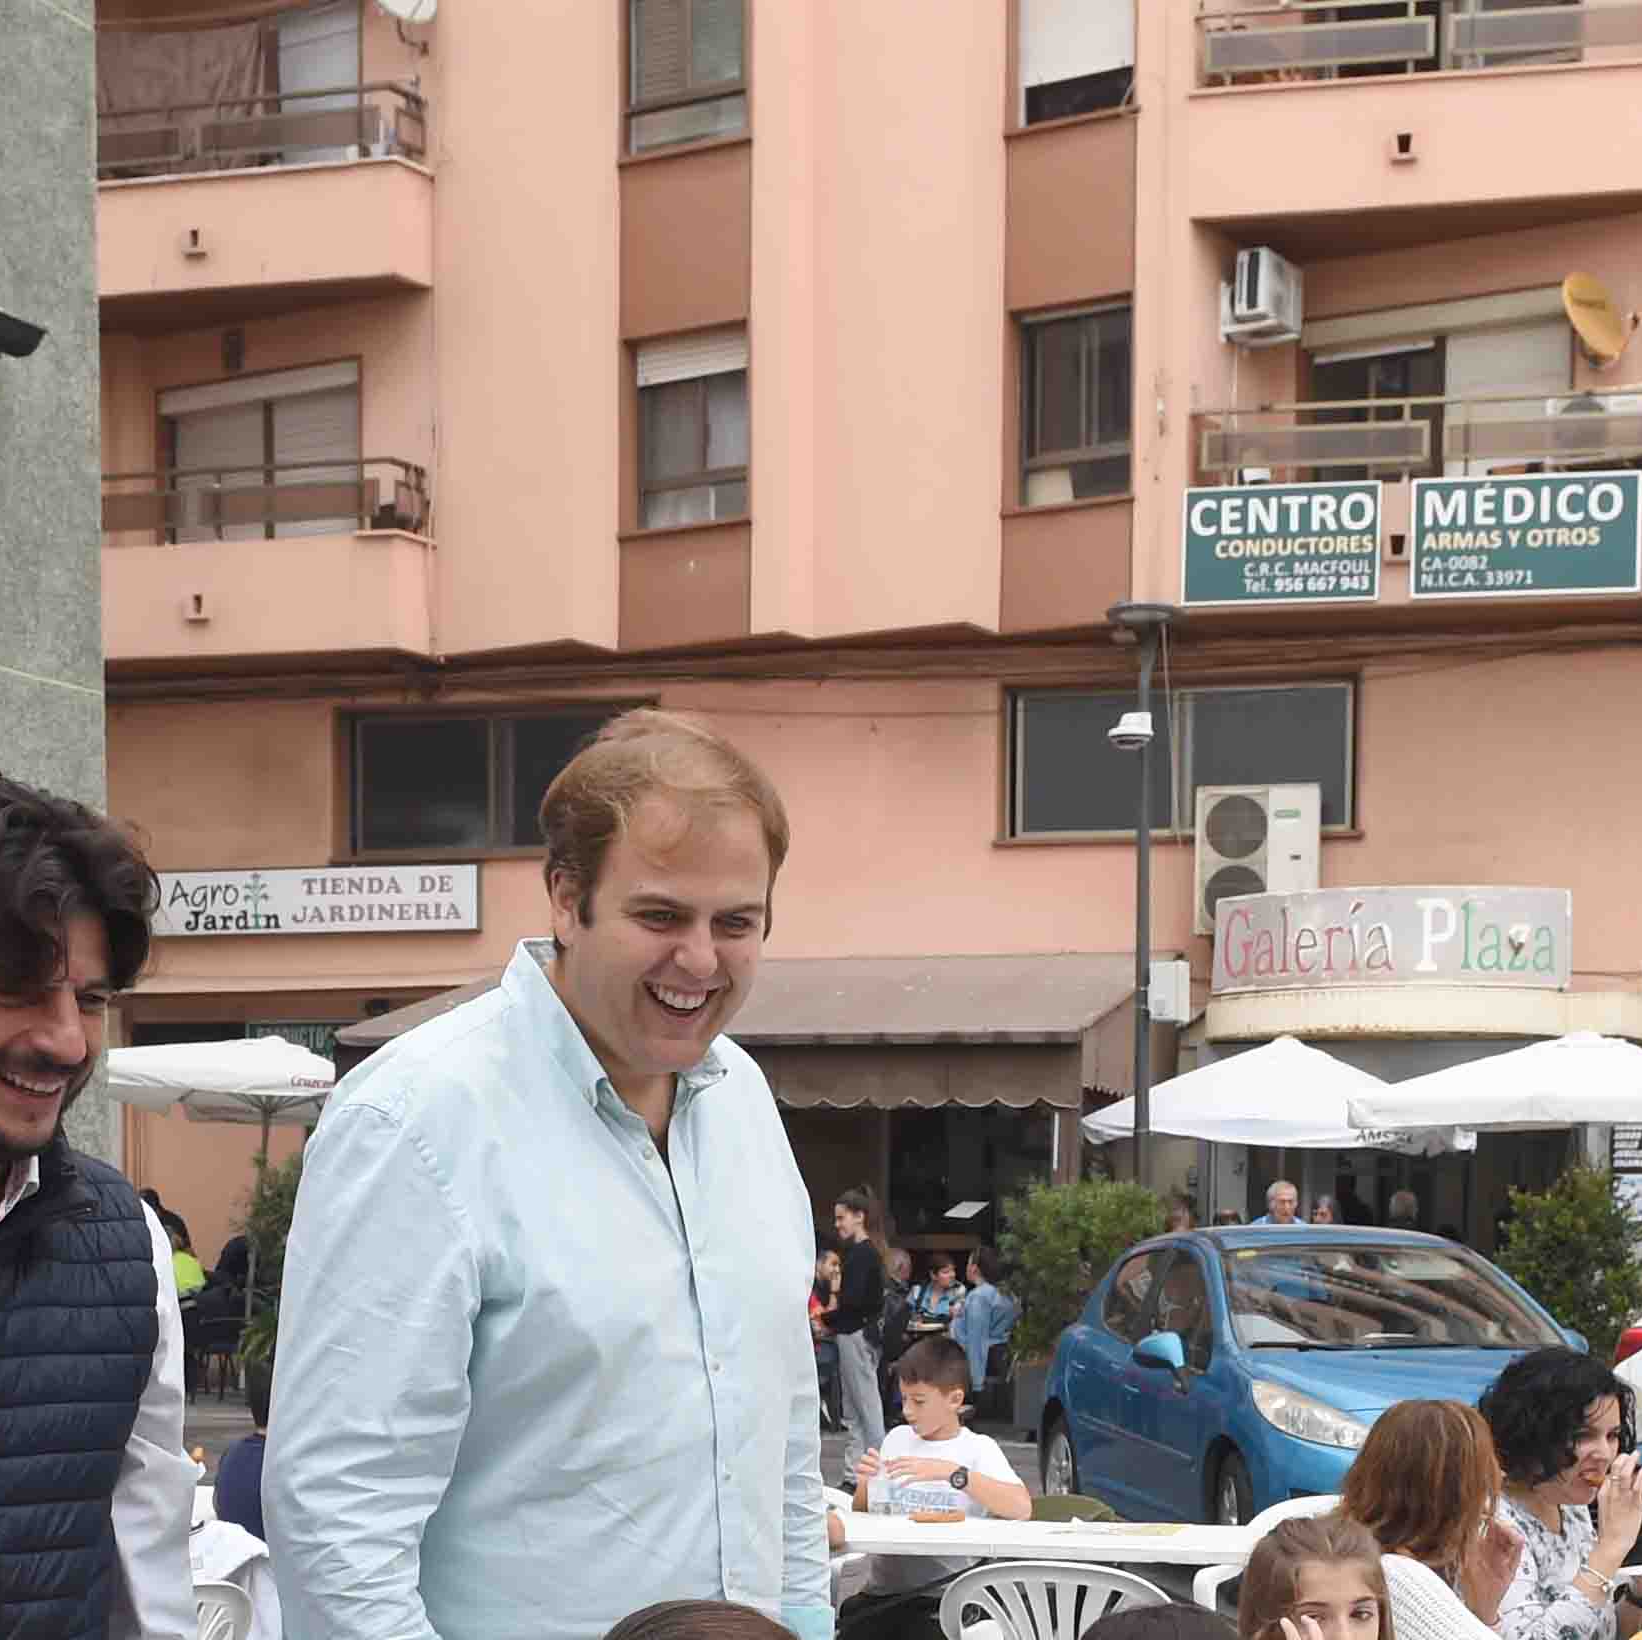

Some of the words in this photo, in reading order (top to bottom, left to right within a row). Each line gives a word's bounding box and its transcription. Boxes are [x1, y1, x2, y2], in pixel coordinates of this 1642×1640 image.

[1190, 492, 1375, 536] CENTRO
[1424, 482, 1624, 527] MÉDICO
[1214, 535, 1374, 559] CONDUCTORES
[1422, 529, 1502, 551] ARMAS
[1507, 529, 1522, 548] Y
[1526, 526, 1601, 548] OTROS
[1293, 559, 1372, 576] MACFOUL
[1485, 569, 1533, 586] 33971
[1244, 578, 1270, 593] Tel.
[1274, 577, 1304, 592] 956
[169, 880, 240, 914] Agro
[302, 876, 403, 897] TIENDA
[418, 875, 454, 894] DE
[292, 902, 462, 925] JARDINERIA
[1224, 901, 1394, 978] Galería
[1412, 897, 1557, 973] Plaza
